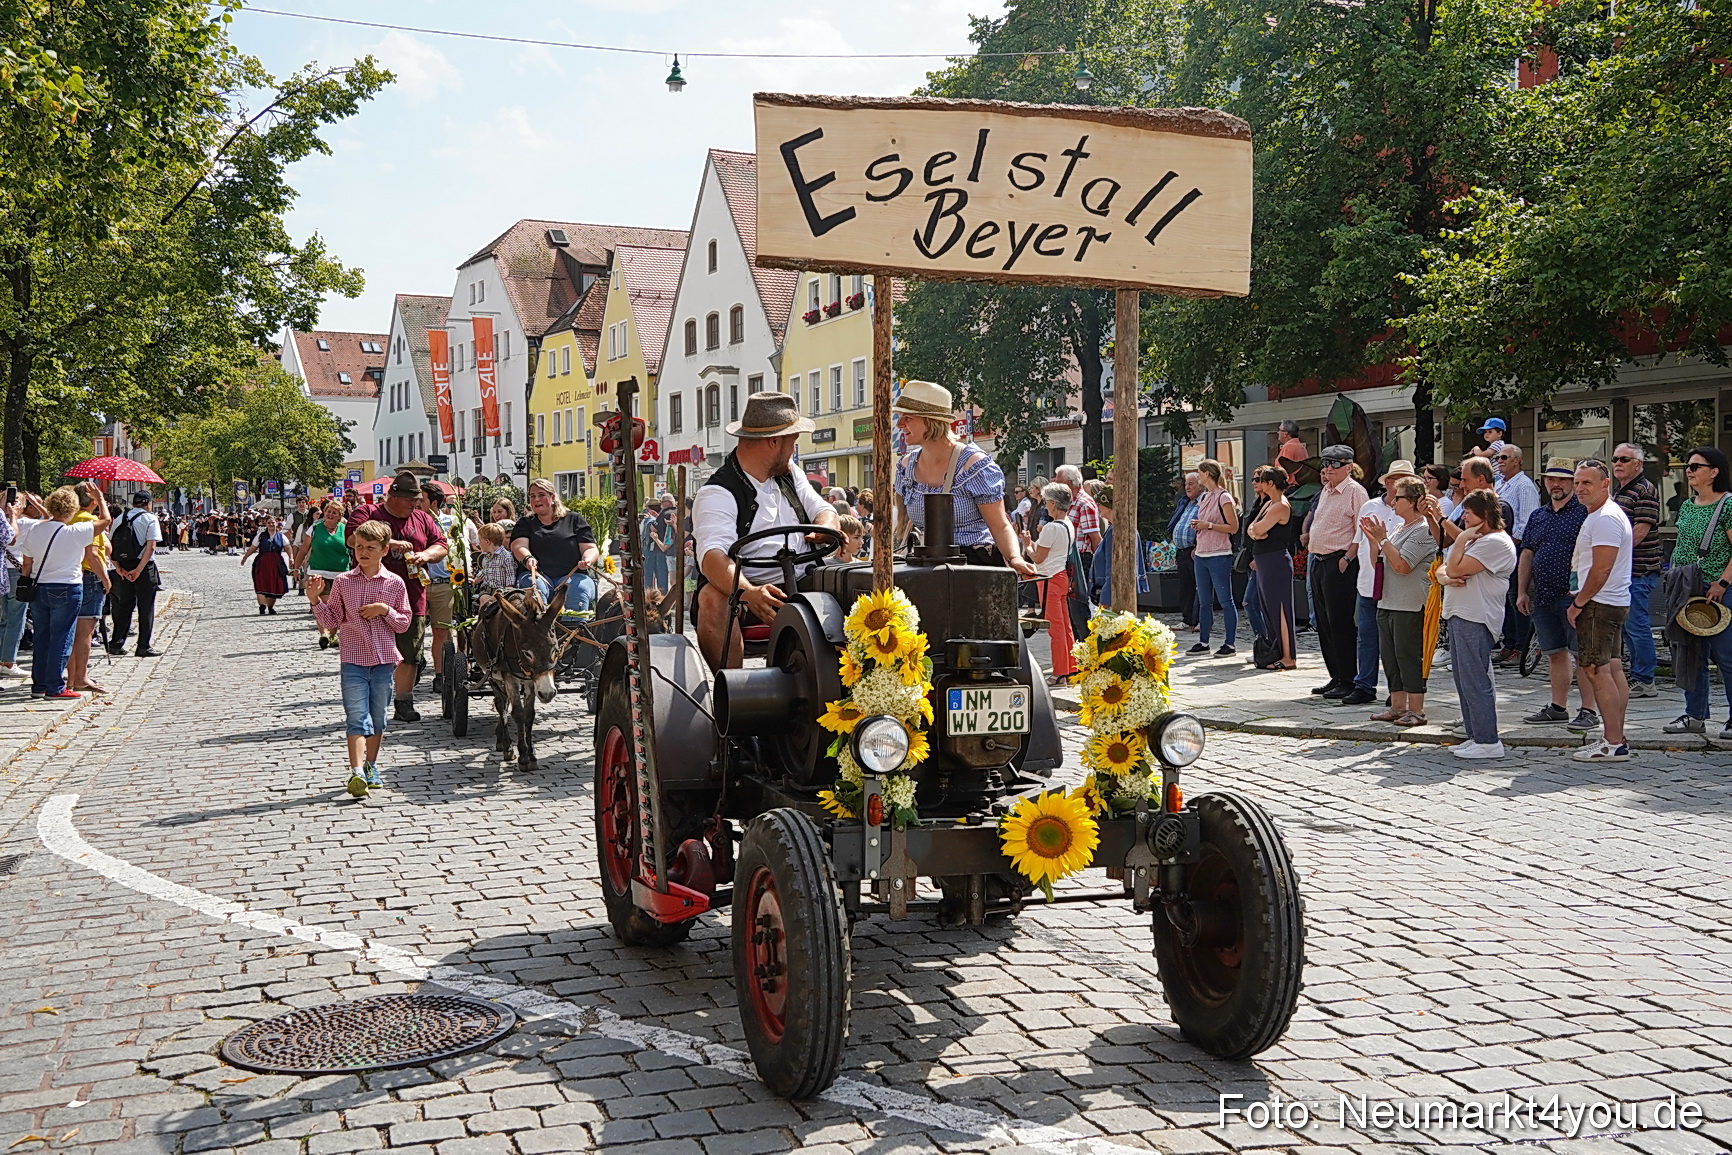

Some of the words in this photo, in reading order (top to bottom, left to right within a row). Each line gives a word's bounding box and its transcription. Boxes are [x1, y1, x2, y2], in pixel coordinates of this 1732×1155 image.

[913, 188, 1111, 270] Beyer
[477, 351, 495, 399] SALE
[556, 391, 571, 405] HOTEL
[966, 690, 991, 710] NM
[953, 712, 977, 732] WW
[988, 711, 1024, 732] 200
